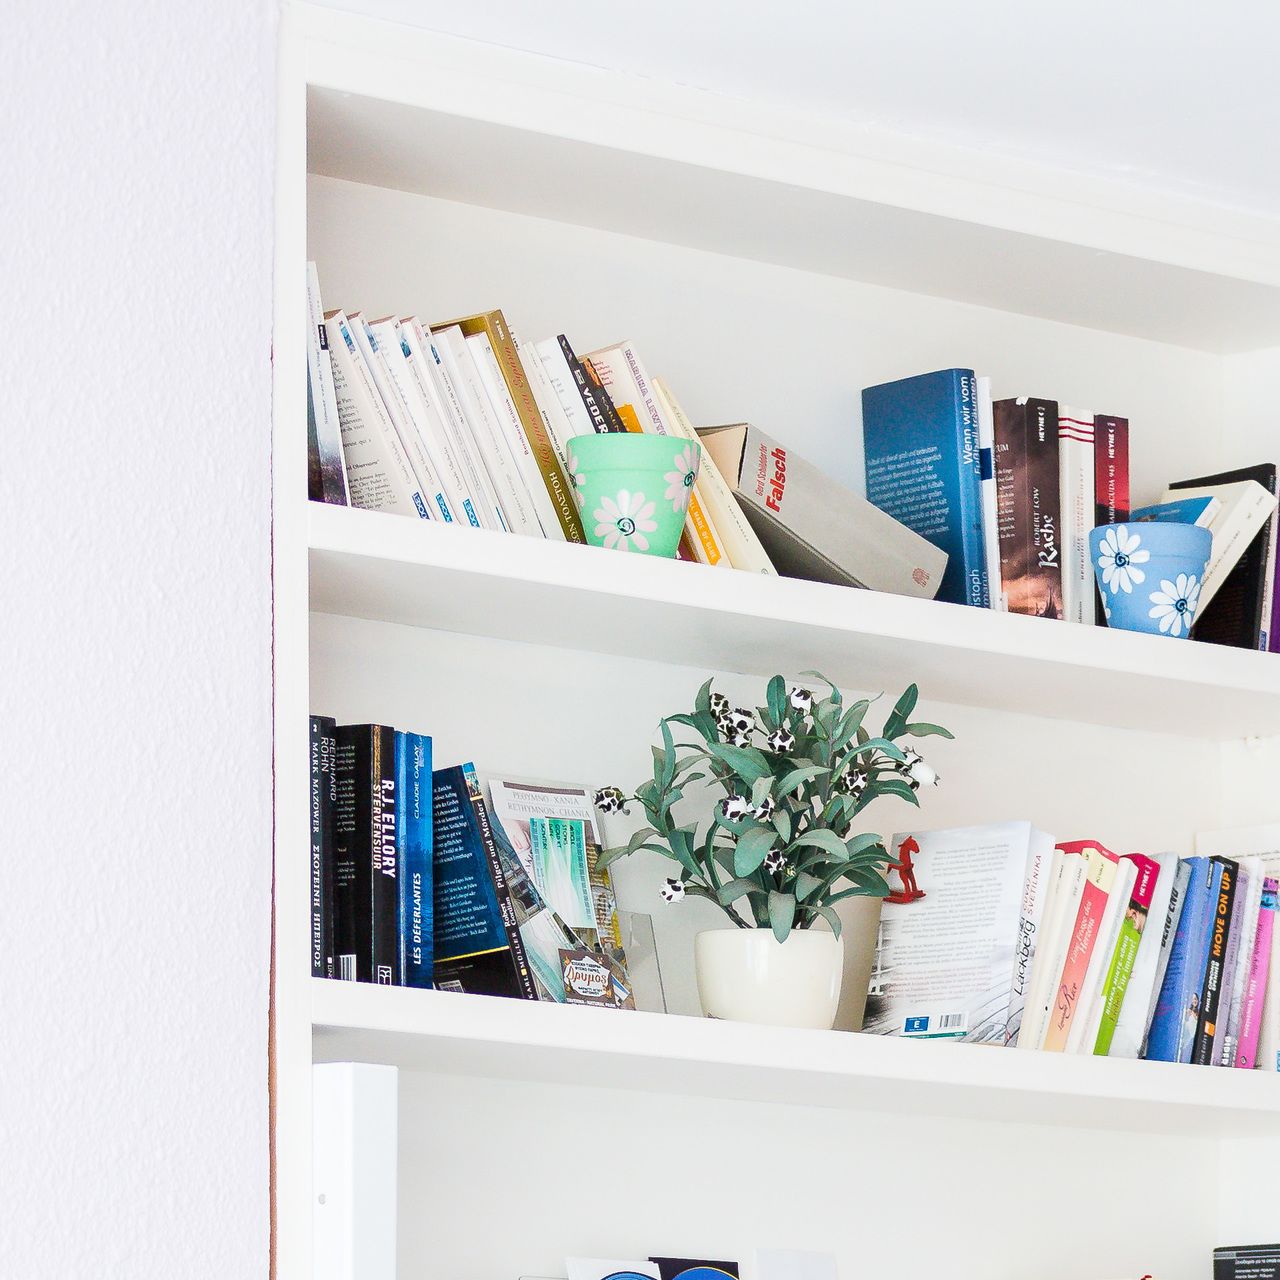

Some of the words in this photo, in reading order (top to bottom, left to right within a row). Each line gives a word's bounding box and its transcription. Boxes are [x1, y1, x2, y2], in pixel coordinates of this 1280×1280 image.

[625, 349, 648, 397] MARINA
[960, 376, 970, 403] vom
[504, 398, 519, 425] Schlink
[960, 406, 970, 426] wir
[514, 424, 529, 456] Bernhard
[963, 430, 974, 466] Wenn
[766, 448, 786, 513] Falsch
[1038, 515, 1059, 569] Rache
[312, 742, 320, 774] MARK
[321, 736, 330, 773] ROHN
[329, 738, 337, 802] REINHARD
[312, 778, 320, 833] MAZOWER
[381, 780, 395, 808] R.J.
[372, 784, 382, 870] STERVENSUUR
[477, 802, 491, 838] Mörder
[381, 813, 396, 878] ELLORY
[486, 839, 497, 859] und
[312, 844, 321, 908] ΣΚΟΤΕΙΝΗ
[492, 859, 505, 889] Pilger
[1222, 872, 1233, 891] UP
[1219, 894, 1229, 915] ON
[313, 912, 321, 968] ΗΠΕΙΡΟΣ
[1212, 917, 1226, 957] MOVE
[413, 947, 422, 965] LES
[1013, 919, 1036, 996] Läckberg
